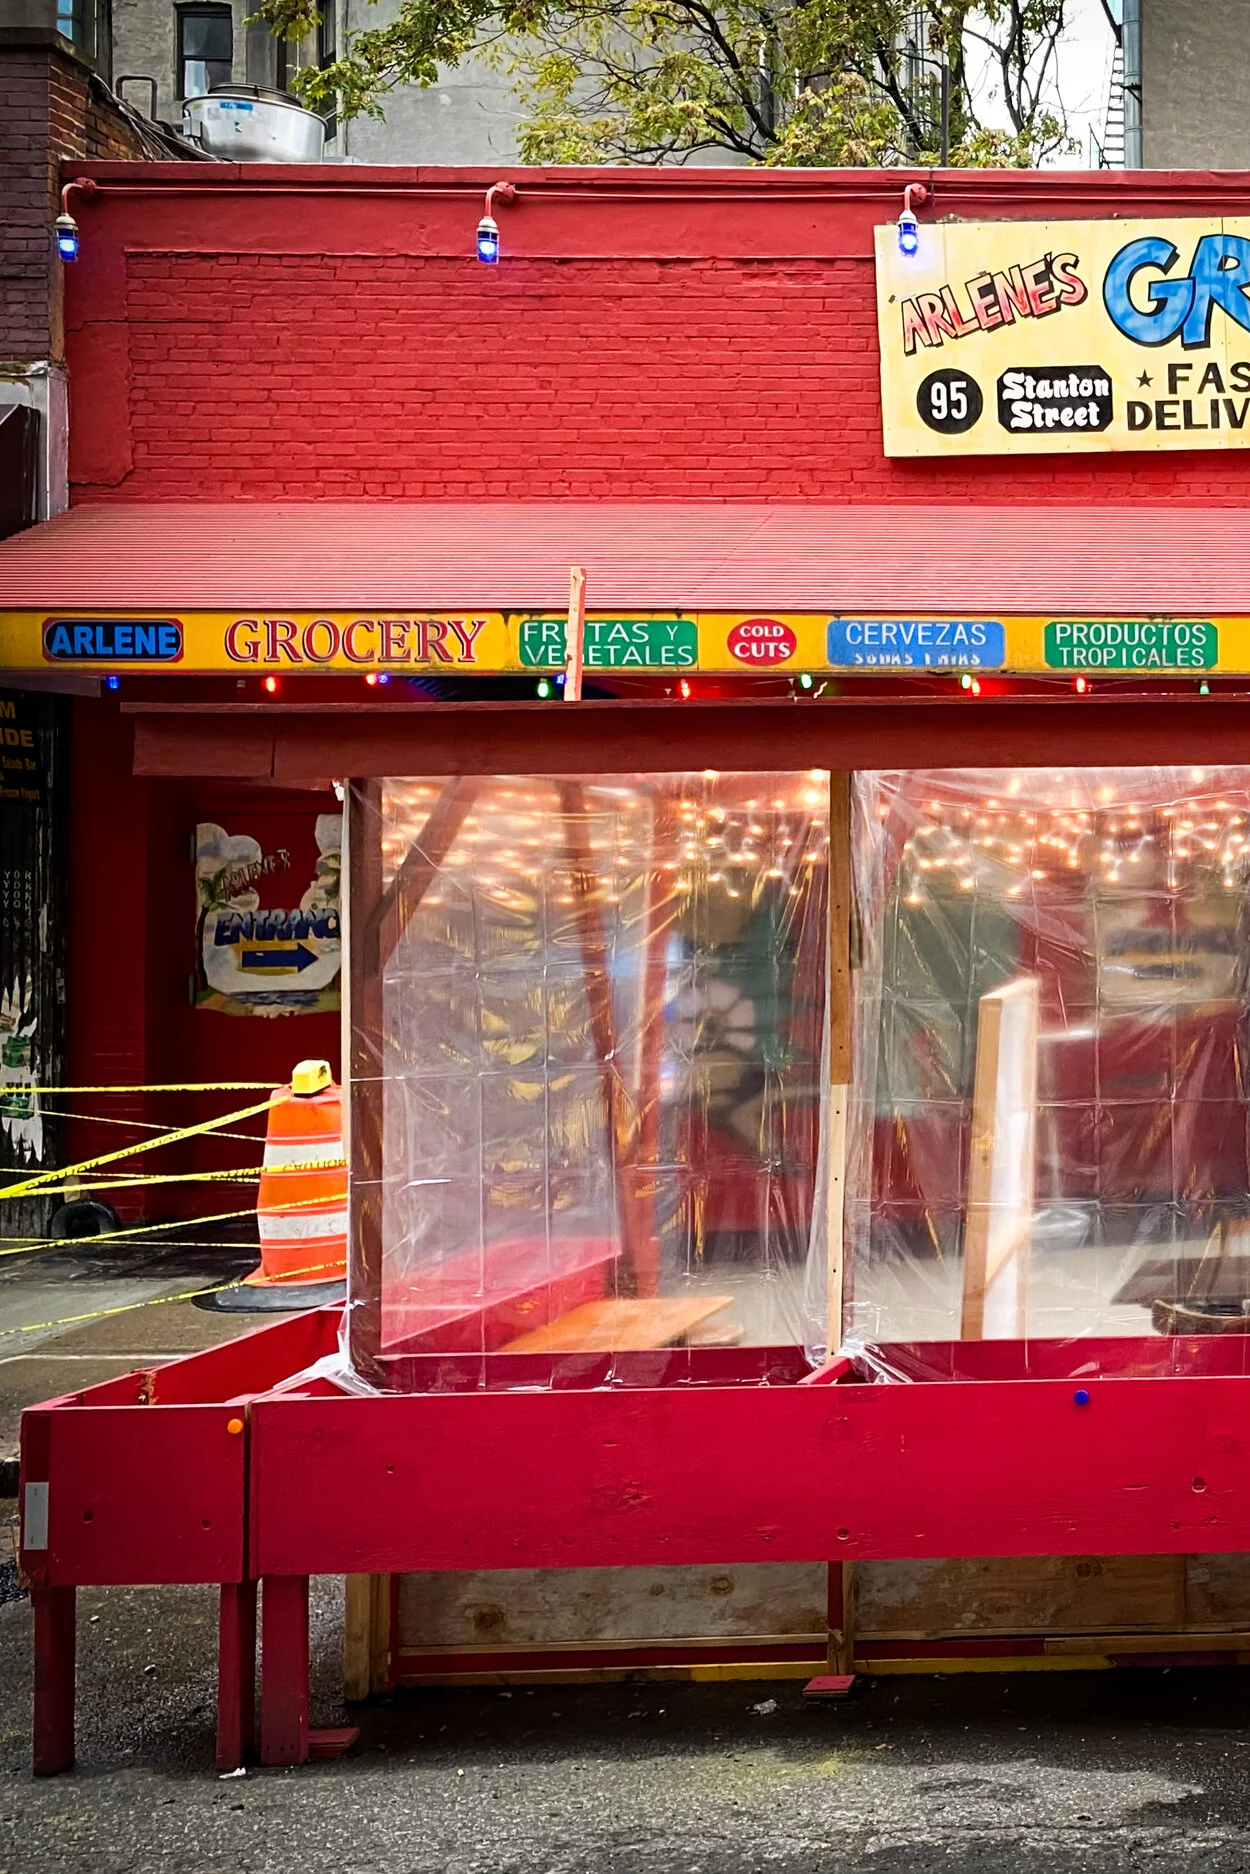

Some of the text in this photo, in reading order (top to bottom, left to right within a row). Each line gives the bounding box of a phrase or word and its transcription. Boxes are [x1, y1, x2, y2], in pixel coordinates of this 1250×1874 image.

[901, 251, 1088, 356] ARLENE'S
[1002, 372, 1110, 400] Stanton
[930, 381, 968, 420] 95
[1010, 401, 1100, 429] Street
[51, 619, 487, 663] ARLENE GROCERY
[524, 622, 679, 643] FRTAS Y
[739, 625, 784, 638] COLD
[846, 623, 987, 646] CERVEZAS
[1056, 624, 1207, 646] PRODUCTOS
[525, 645, 694, 665] VEETALES
[734, 642, 790, 658] CUTS
[1059, 648, 1204, 667] TROPICALES
